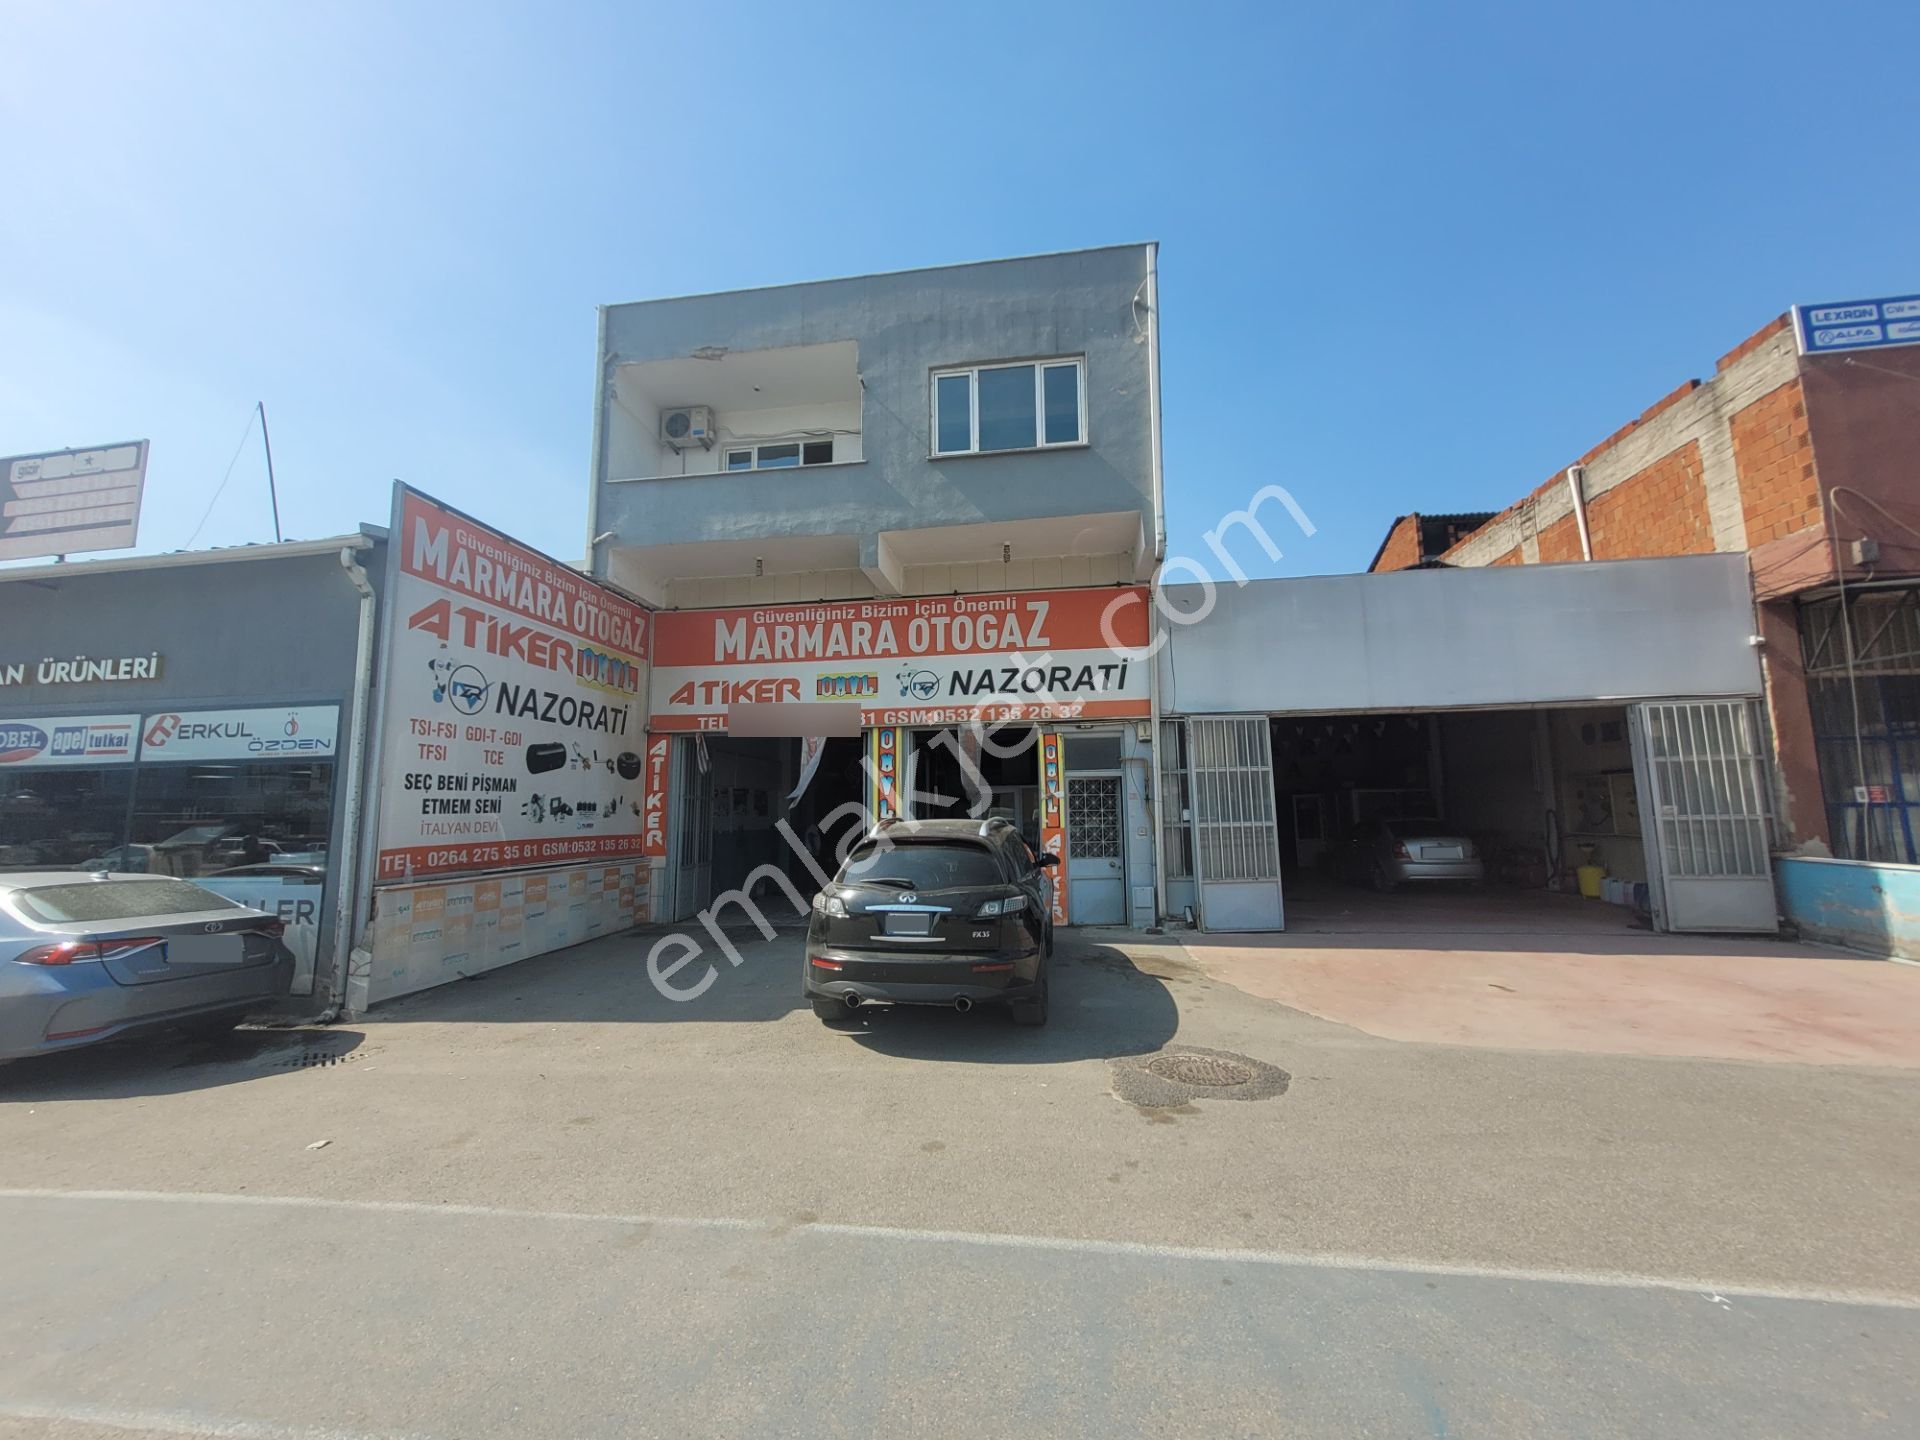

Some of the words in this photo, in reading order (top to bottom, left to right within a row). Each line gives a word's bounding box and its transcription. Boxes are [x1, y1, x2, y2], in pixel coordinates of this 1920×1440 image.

[1815, 308, 1873, 322] LEXRON
[456, 529, 541, 580] Güvenliğiniz
[544, 569, 575, 595] Bizim
[579, 583, 598, 605] İçin
[412, 515, 568, 627] MARMARA
[573, 599, 645, 656] OTOGAZ
[753, 607, 855, 623] Güvenliğiniz
[861, 604, 908, 618] Bizim
[915, 600, 947, 617] İçin
[953, 597, 1017, 613] Önemli
[714, 617, 899, 662] MARMARA
[908, 600, 1050, 653] OTOGAZ
[37, 652, 158, 684] ÜRÜNLERİ
[949, 658, 1129, 696] NAZORATİ
[496, 681, 629, 735] NAZORATİ
[987, 706, 1021, 720] 135
[1029, 706, 1052, 719] 26
[1060, 705, 1082, 719] 32
[53, 728, 87, 753] apel
[89, 733, 129, 748] tutkal
[178, 722, 253, 739] ERKUL
[410, 718, 457, 739] TSI-FSI
[248, 737, 331, 751] ÖZDEN
[418, 743, 447, 761] TFSI
[484, 750, 504, 765] TCE
[404, 773, 433, 794] SEÇ
[437, 772, 468, 791] BENİ
[471, 773, 517, 795] PİŞMAN
[422, 798, 471, 815] ETMEM
[475, 796, 502, 814] SENİ
[420, 820, 471, 836] İTALYAN
[382, 852, 421, 872] TEL:
[427, 849, 468, 867] 0264
[473, 847, 499, 863] 275
[504, 845, 520, 860] 35
[524, 843, 538, 858] 81
[600, 838, 615, 850] 135
[618, 838, 629, 849] 26
